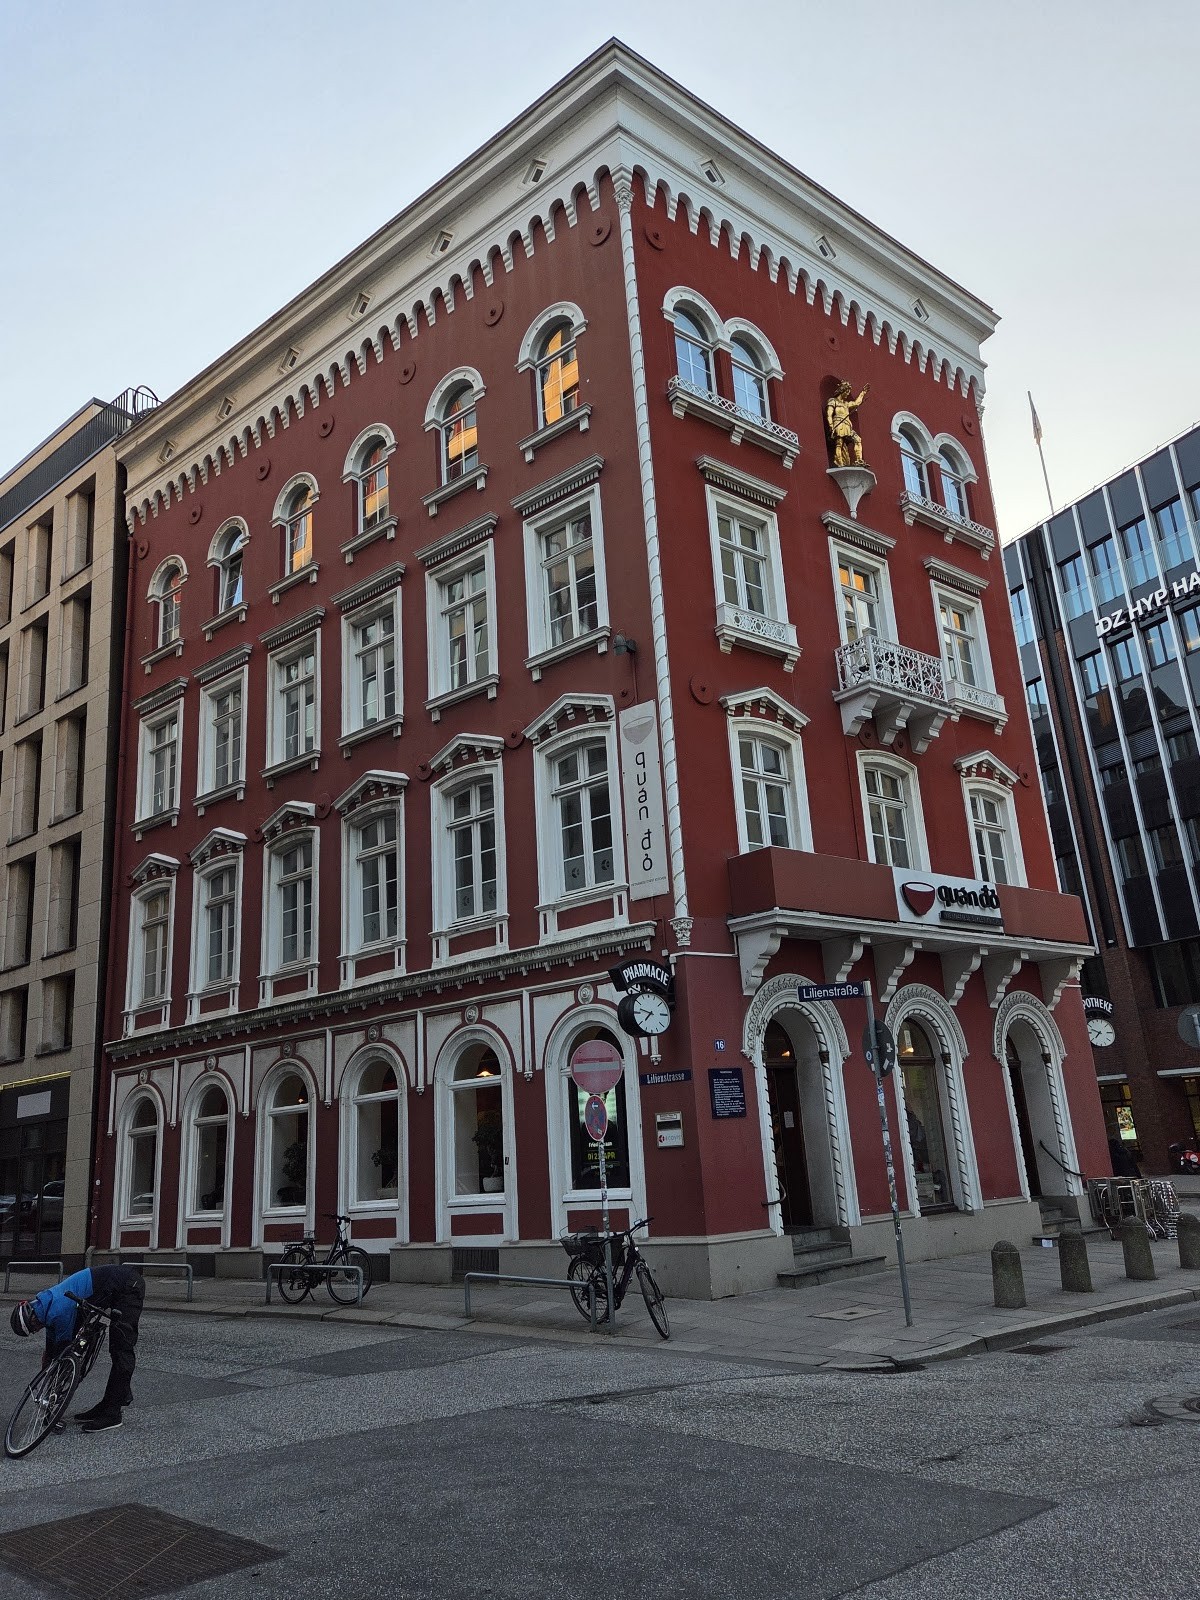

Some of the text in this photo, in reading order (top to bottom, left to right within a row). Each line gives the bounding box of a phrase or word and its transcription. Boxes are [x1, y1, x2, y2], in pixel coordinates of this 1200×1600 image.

[1098, 608, 1126, 637] DZ
[1128, 588, 1168, 620] HYP
[622, 963, 670, 986] PHARMACIE
[802, 984, 859, 999] Lilienstraße
[716, 1040, 724, 1050] 16
[646, 1072, 685, 1085] Lilienstrasse
